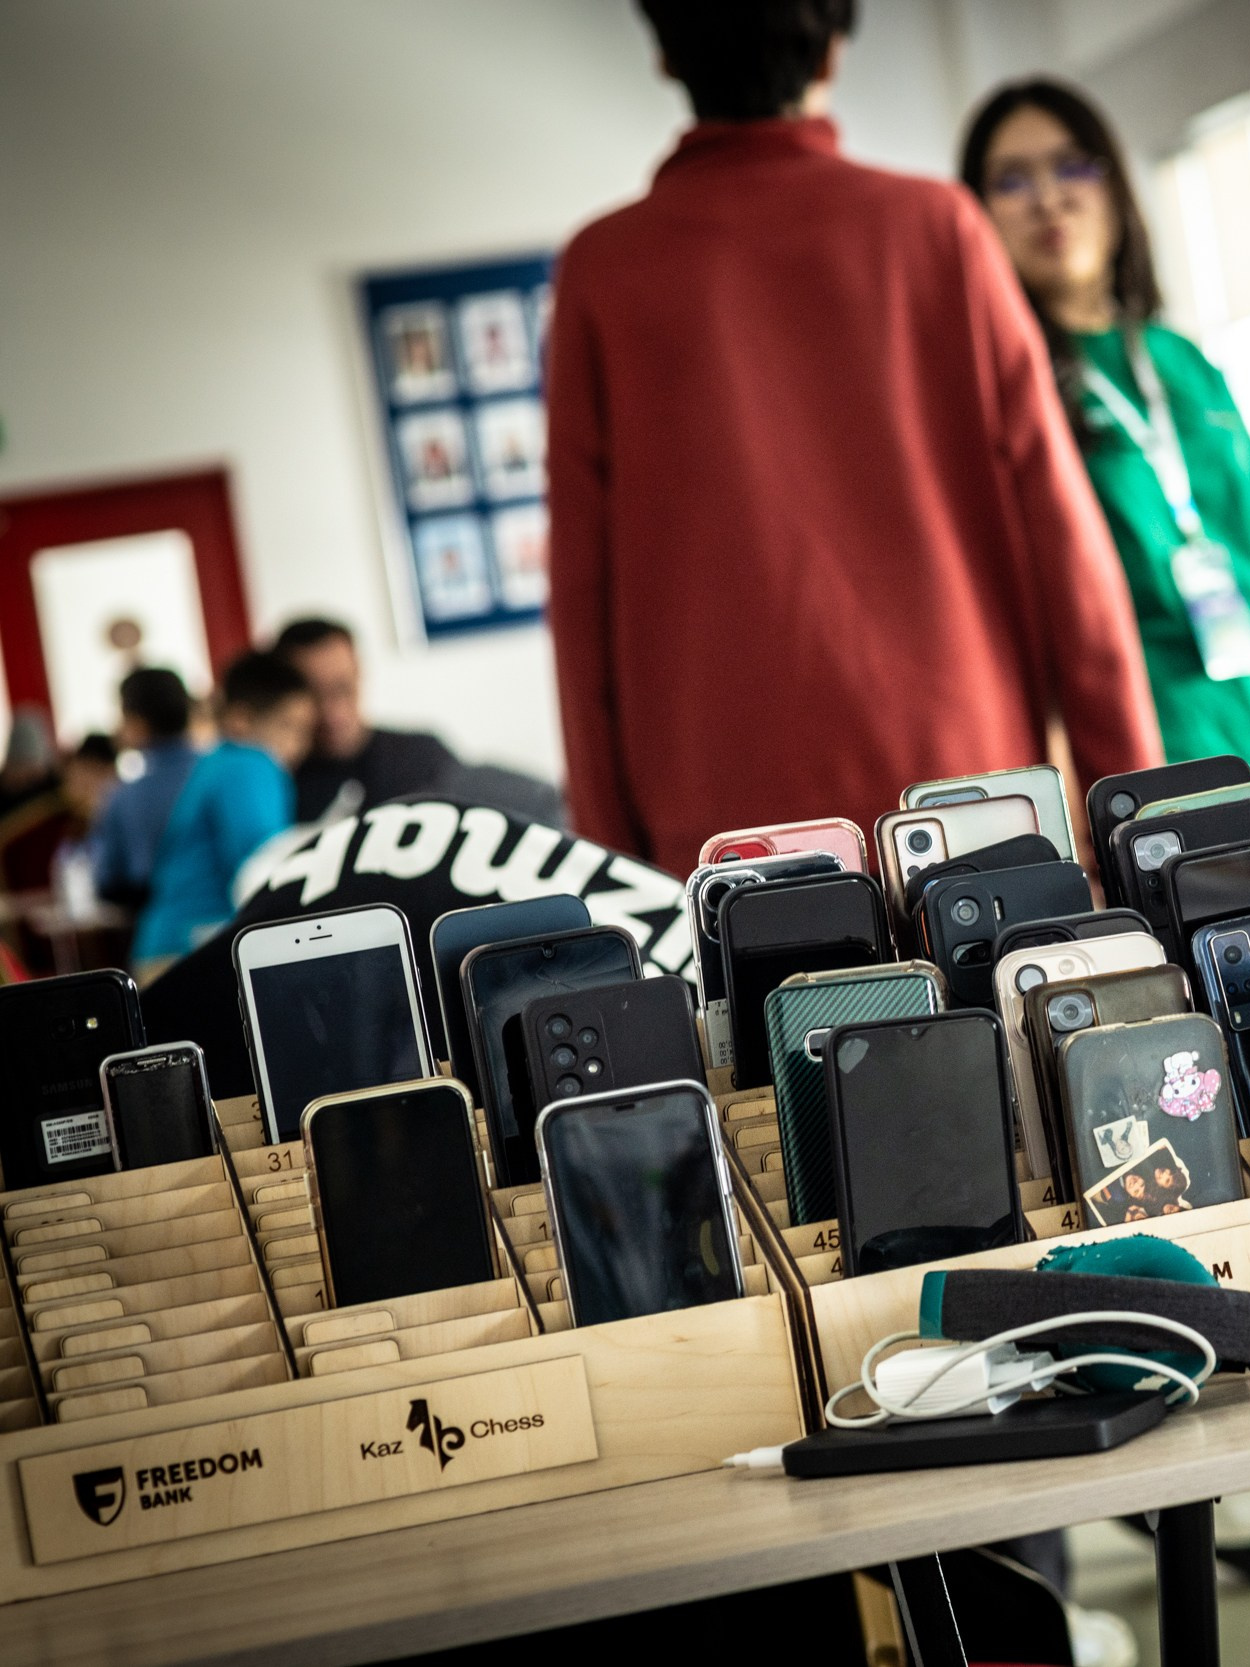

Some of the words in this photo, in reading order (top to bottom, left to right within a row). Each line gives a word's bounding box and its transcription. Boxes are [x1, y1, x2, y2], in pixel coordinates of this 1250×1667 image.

[41, 1079, 94, 1096] SAMSUN
[267, 1150, 293, 1172] 31
[1042, 1186, 1056, 1206] 4
[813, 1228, 841, 1251] 45
[830, 1256, 843, 1276] 4
[360, 1440, 404, 1460] Kaz
[470, 1413, 545, 1439] Chess
[136, 1448, 263, 1491] FREEDOM
[139, 1486, 193, 1511] BANK
